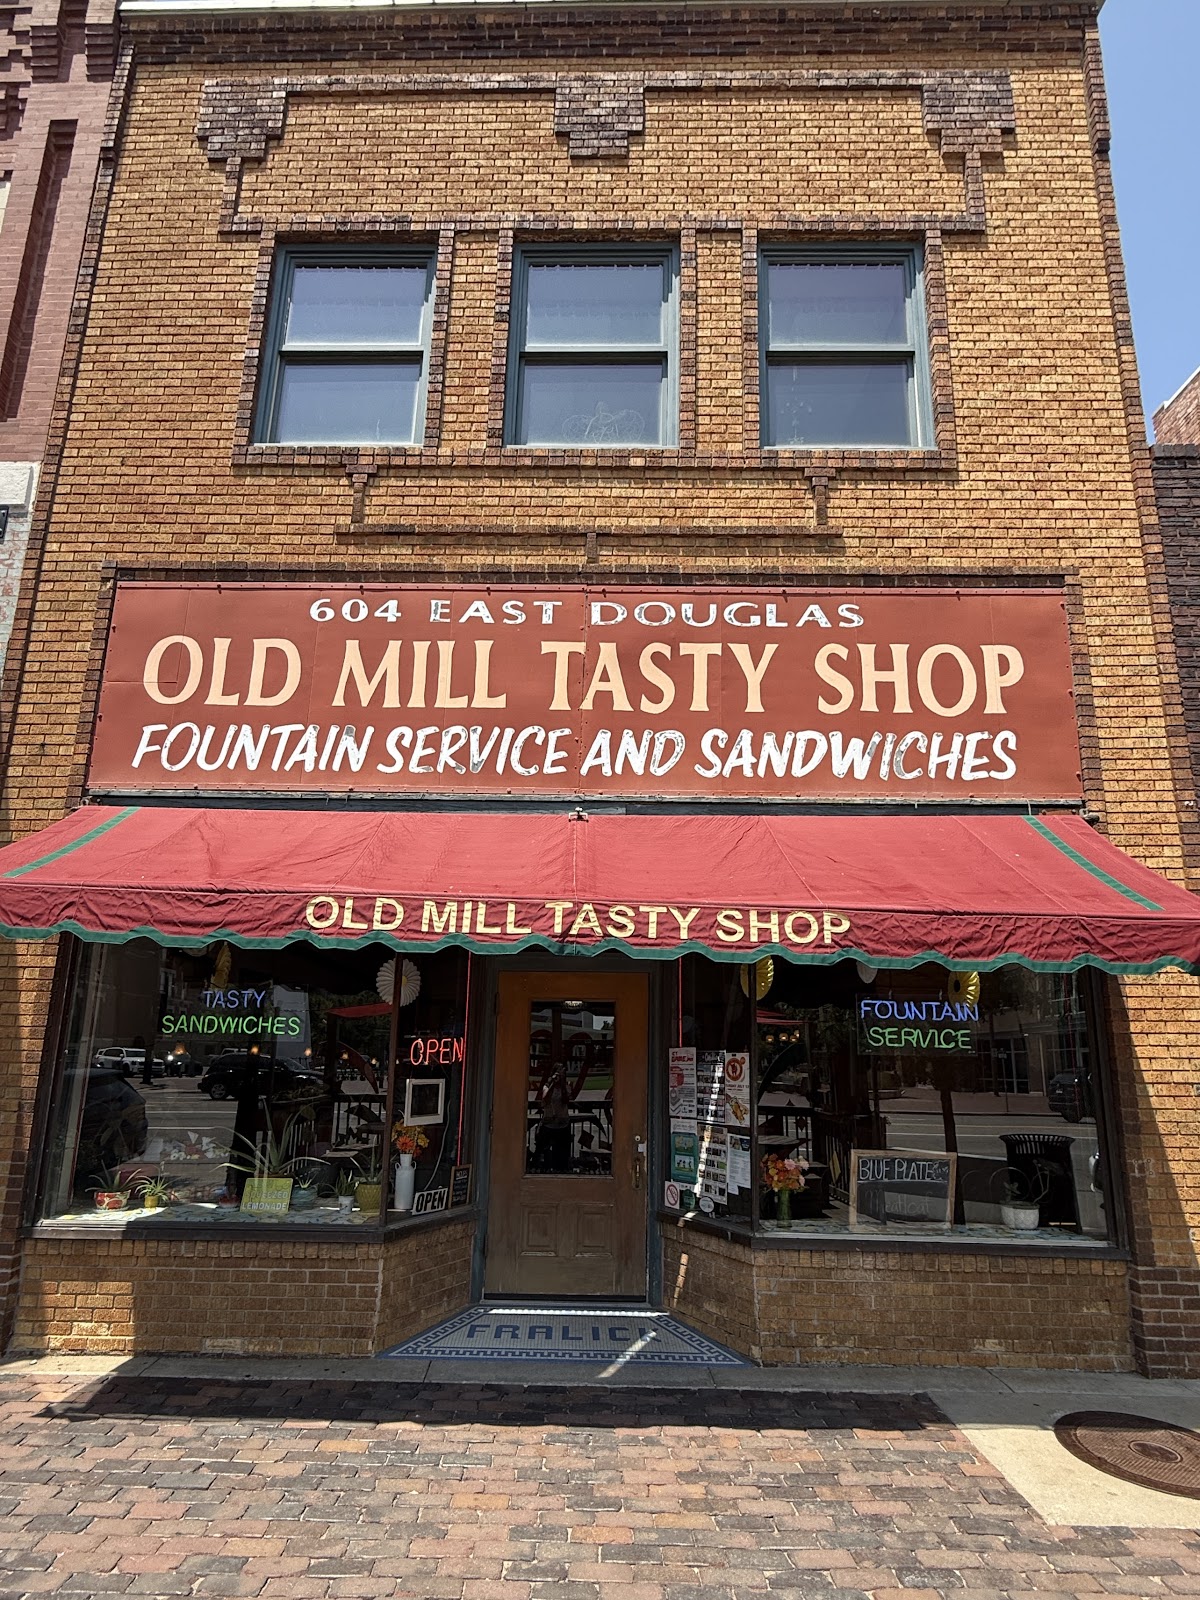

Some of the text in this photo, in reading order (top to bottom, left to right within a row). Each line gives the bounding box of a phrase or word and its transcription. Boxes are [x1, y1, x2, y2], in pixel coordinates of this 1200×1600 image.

[309, 598, 865, 628] 604 EAST DOUGLAS
[143, 634, 1025, 717] OLD MILL TASTY SHOP
[131, 722, 1018, 781] FOUNTAIN SERVICE AND SANDWICHES
[305, 895, 852, 945] OLD MILL TASTY SHOP
[203, 989, 266, 1009] TASTY
[860, 999, 980, 1022] FOUNTAIN
[161, 1014, 301, 1036] SANDWICHES
[869, 1026, 972, 1049] SERVICE
[410, 1037, 464, 1066] OPEN
[859, 1158, 934, 1181] BLUE PLATE
[242, 1201, 288, 1211] LEMONADE
[415, 1189, 447, 1213] OPEN
[466, 1324, 662, 1343] FRALICK
